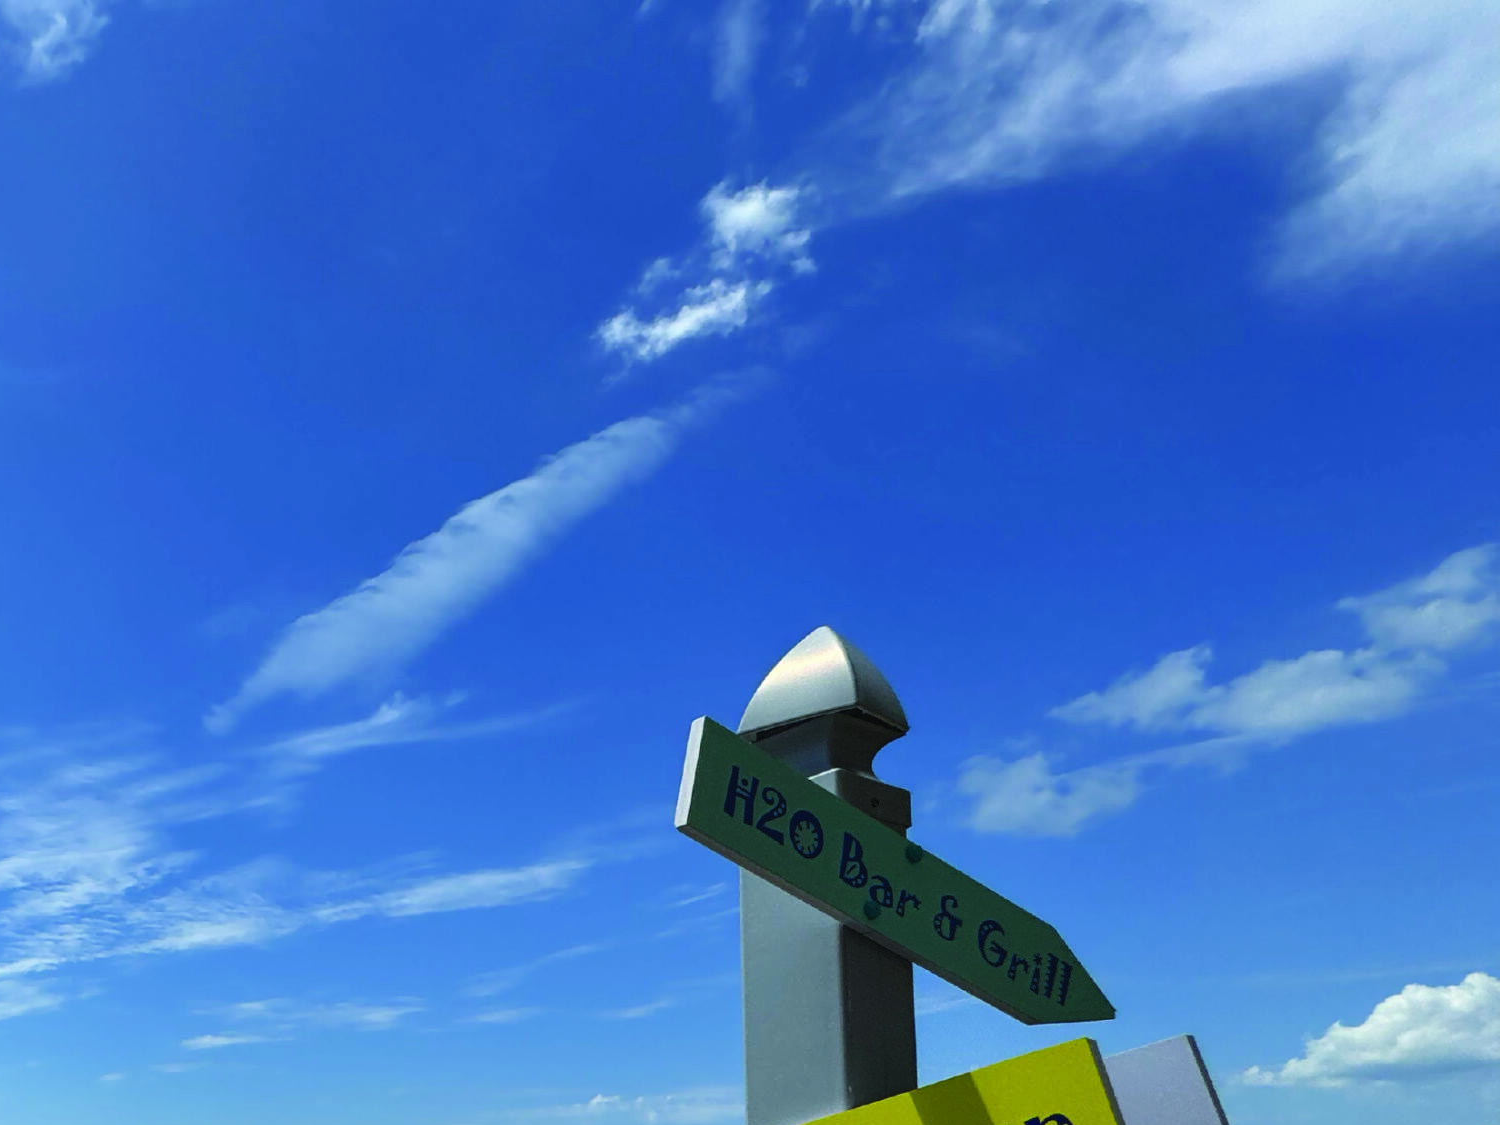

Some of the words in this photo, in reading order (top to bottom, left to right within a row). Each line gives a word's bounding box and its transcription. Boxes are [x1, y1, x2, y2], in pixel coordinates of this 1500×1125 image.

[724, 765, 824, 859] H2O
[839, 832, 922, 917] Bar
[933, 895, 963, 941] &
[977, 919, 1073, 1006] Grill
